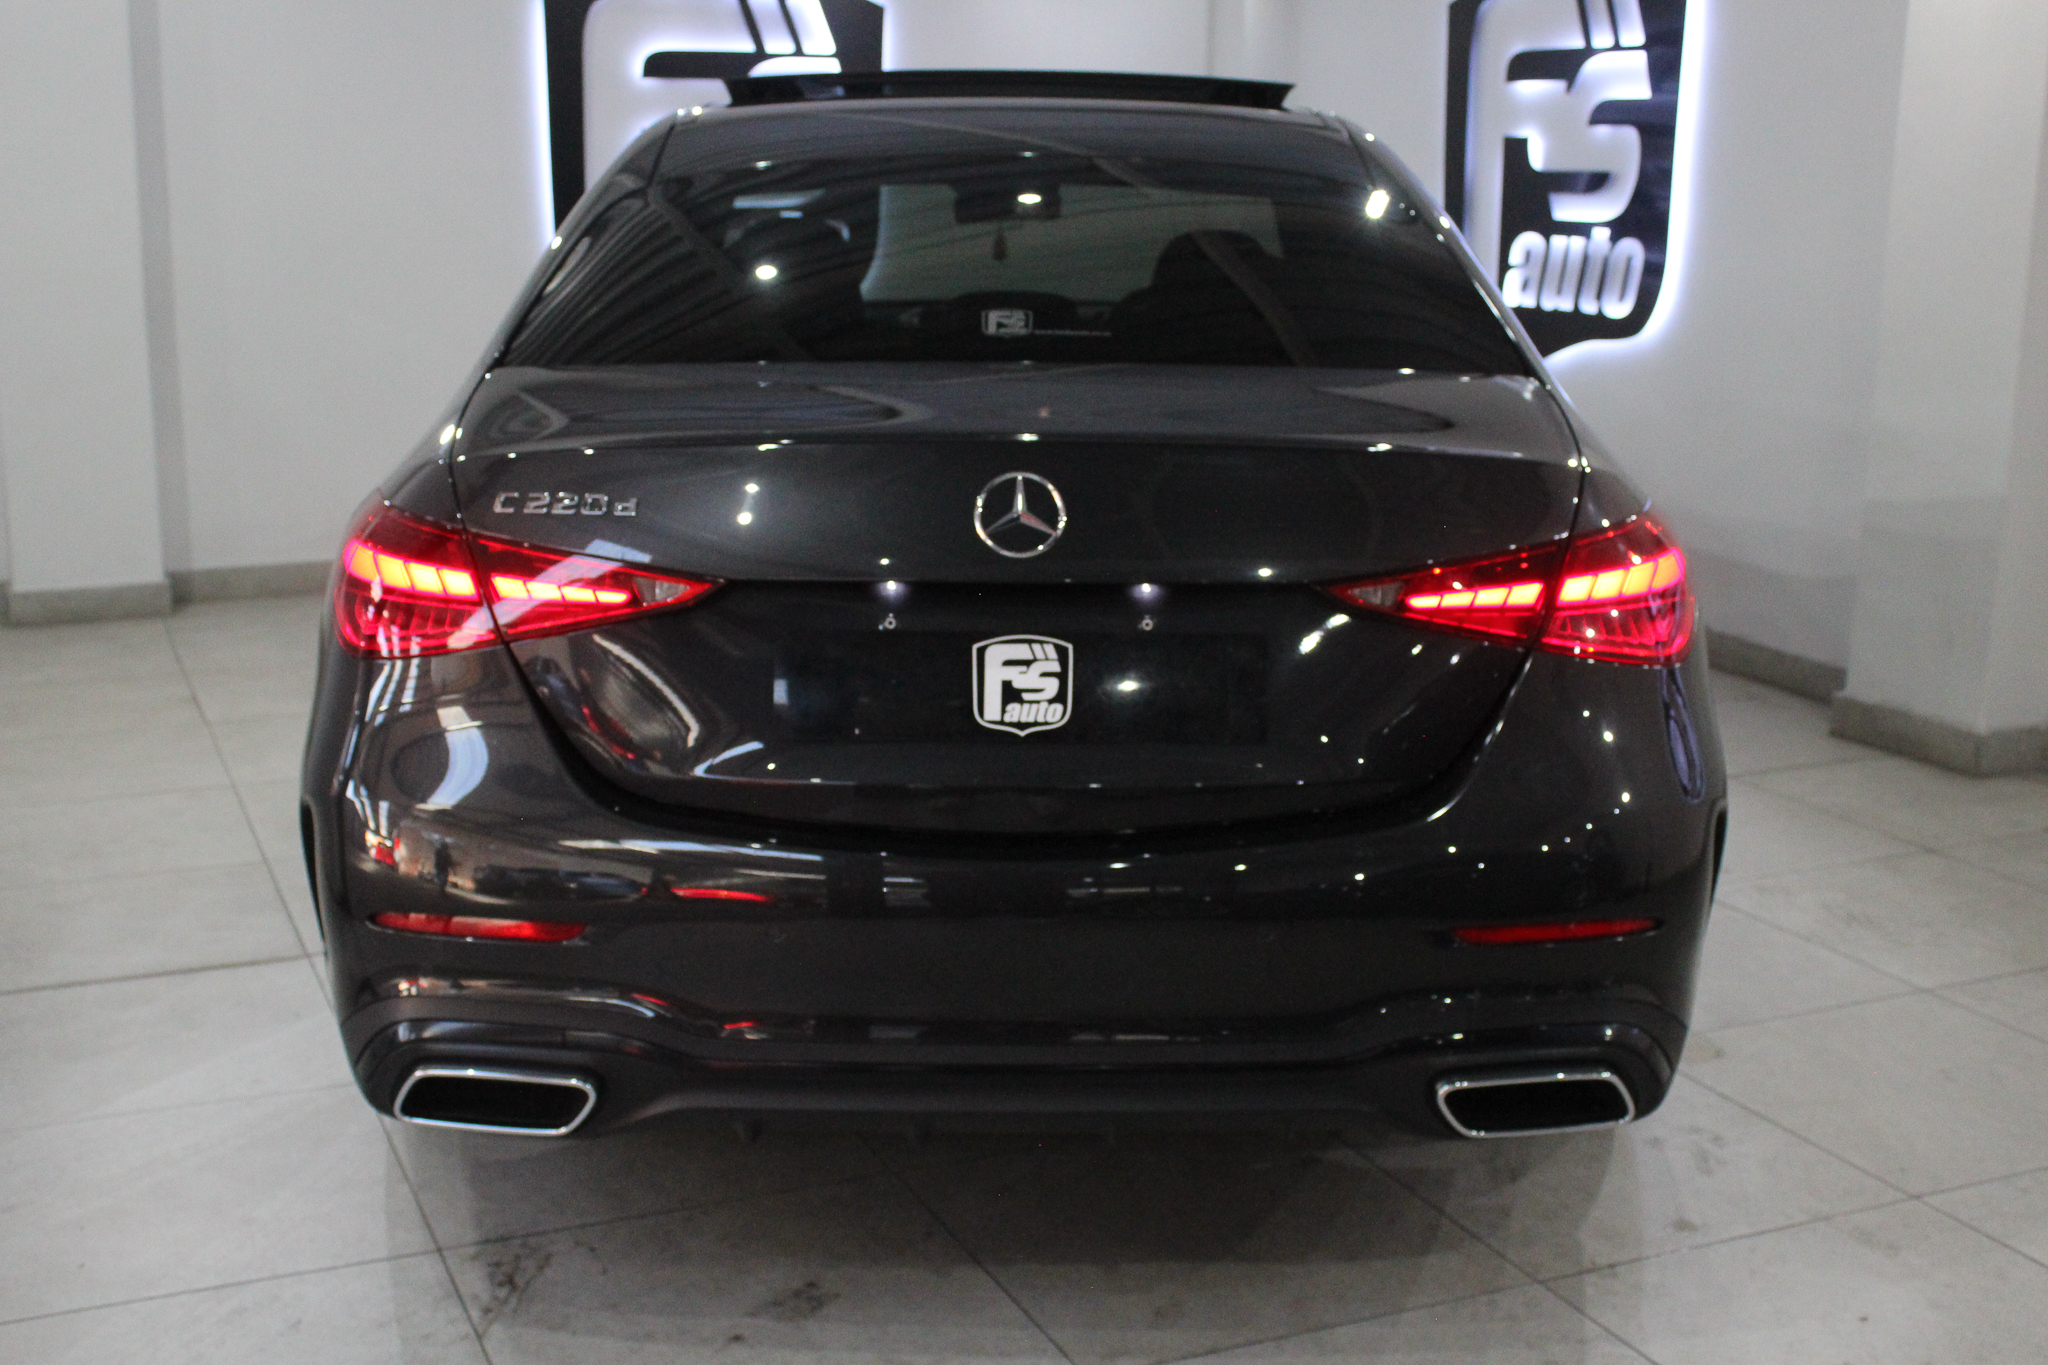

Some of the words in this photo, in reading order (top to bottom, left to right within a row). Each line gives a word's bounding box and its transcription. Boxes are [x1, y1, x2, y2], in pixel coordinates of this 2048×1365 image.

[1464, 0, 1652, 292] FS
[1502, 226, 1646, 320] auto
[493, 491, 519, 513] C
[983, 643, 1061, 721] FS
[1003, 701, 1064, 723] auto
